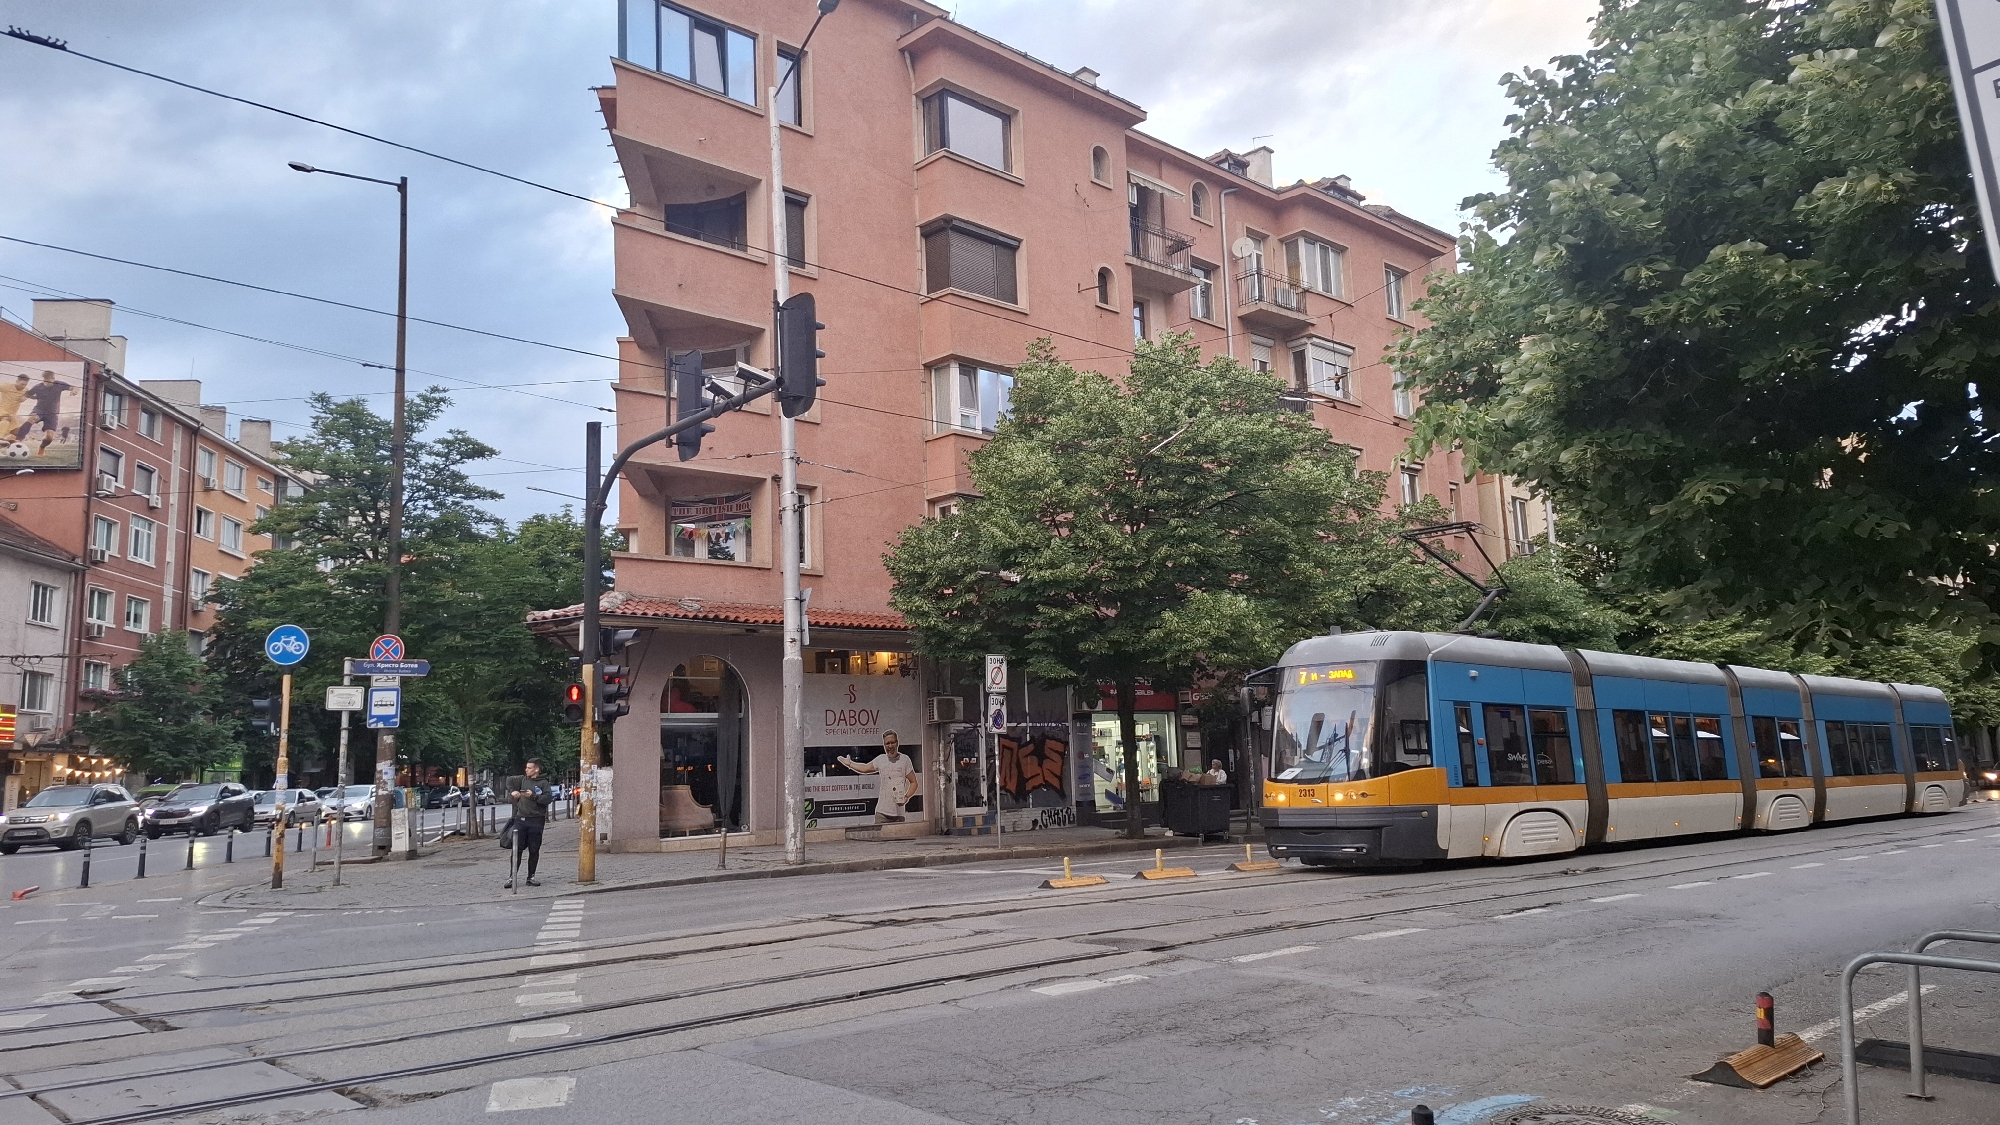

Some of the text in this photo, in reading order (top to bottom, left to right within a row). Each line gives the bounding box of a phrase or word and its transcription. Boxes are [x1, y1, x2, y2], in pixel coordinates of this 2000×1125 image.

[673, 507, 692, 515] THE
[695, 505, 733, 515] BRITISH
[363, 661, 375, 669] бул.
[1299, 671, 1307, 684] 7
[825, 709, 880, 727] DABOV
[825, 727, 880, 736] SPECIALTY COFFEE
[831, 784, 849, 792] COFFEES
[1298, 788, 1316, 798] 2313
